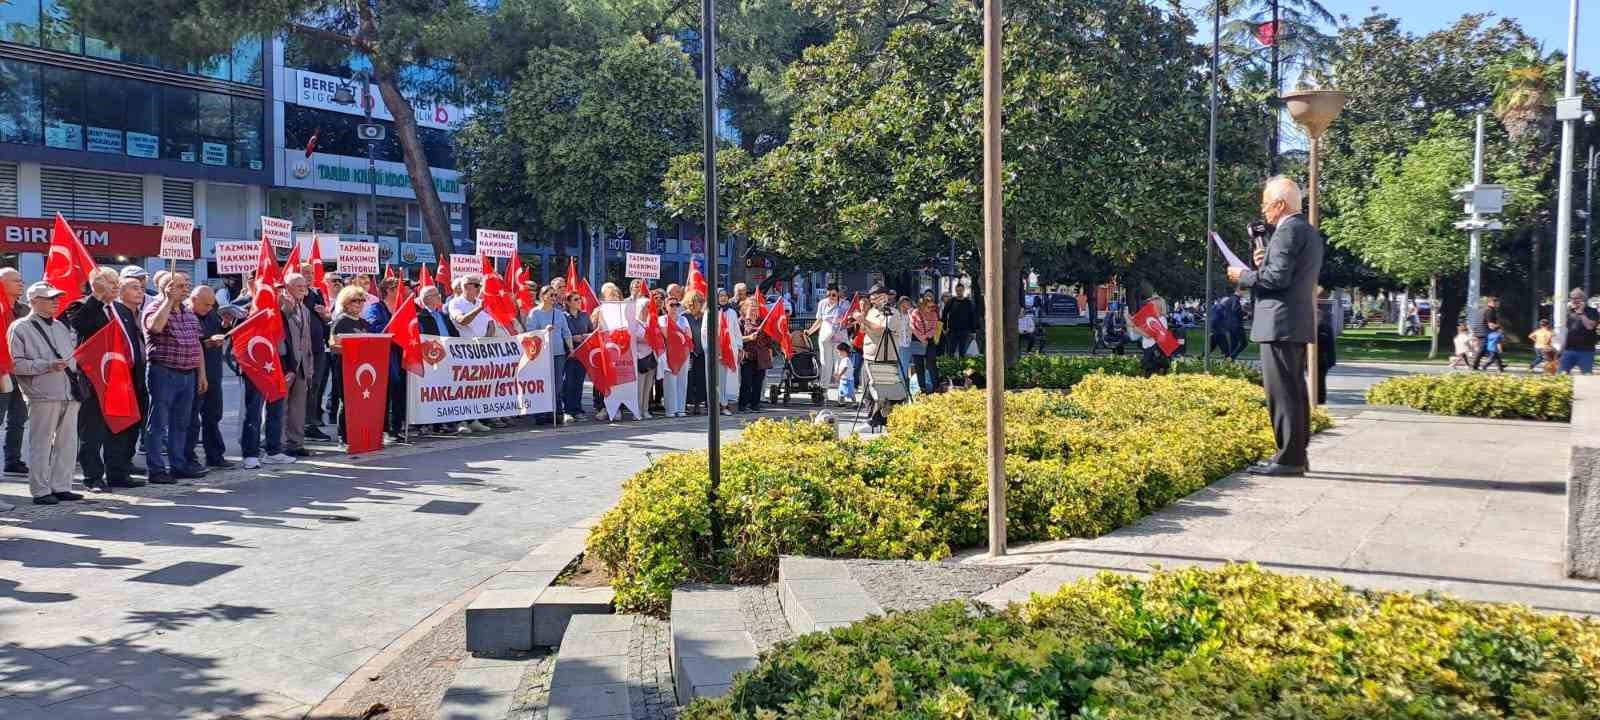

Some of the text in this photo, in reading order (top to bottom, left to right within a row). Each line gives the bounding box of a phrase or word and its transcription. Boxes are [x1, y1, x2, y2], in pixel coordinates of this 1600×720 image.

[340, 243, 376, 253] TAZMİNAT
[340, 254, 377, 263] HAKKIMIZI
[340, 263, 377, 273] İSTİYORUZ
[449, 341, 520, 361] ASTSUBAYLAR
[451, 361, 520, 382] TAZMİNAT
[420, 378, 545, 403] HAKLARINI İSTİYOR
[437, 405, 472, 417] SAMSUN
[483, 400, 532, 413] BAŞKANLIĞI
